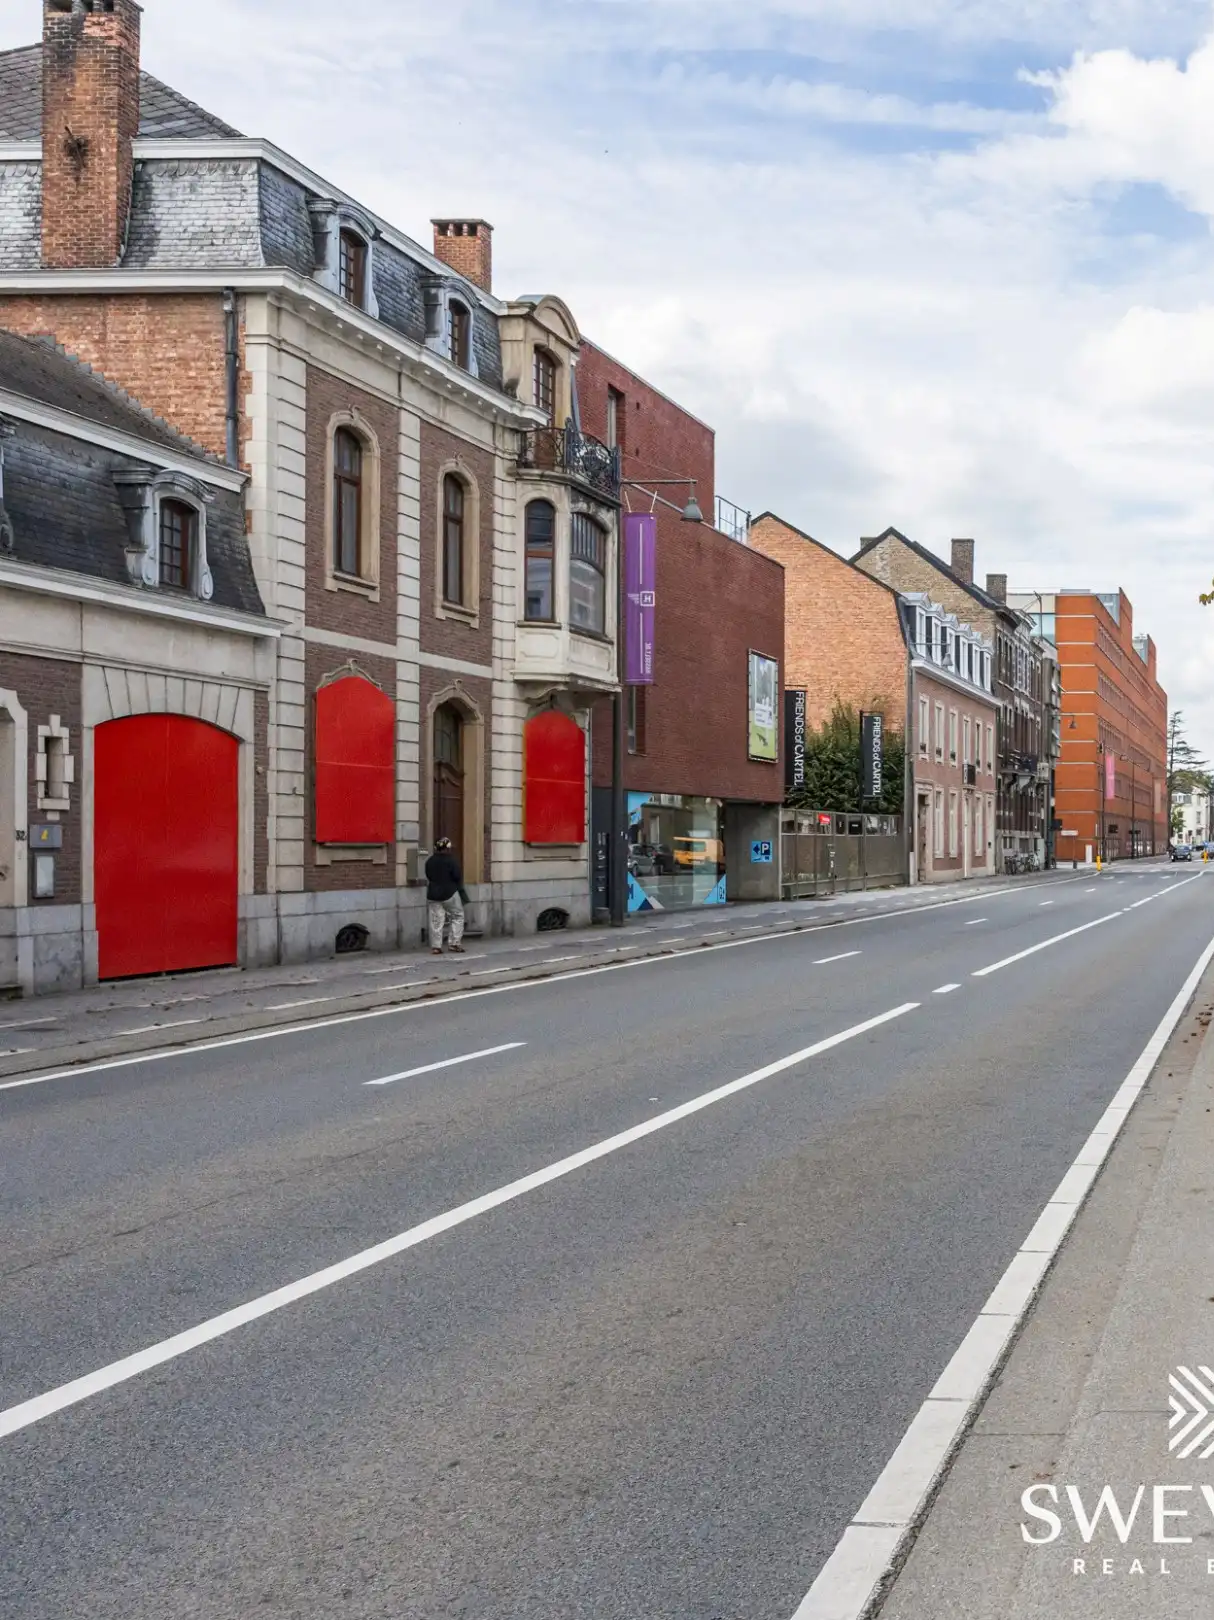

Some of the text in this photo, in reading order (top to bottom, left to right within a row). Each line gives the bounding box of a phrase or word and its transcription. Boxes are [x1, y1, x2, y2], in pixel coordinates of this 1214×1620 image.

[795, 691, 805, 735] FRIENDS
[873, 716, 882, 753] FRIENDS
[794, 744, 805, 786] CARTEL
[872, 761, 882, 796] CARTEL
[761, 843, 770, 854] P
